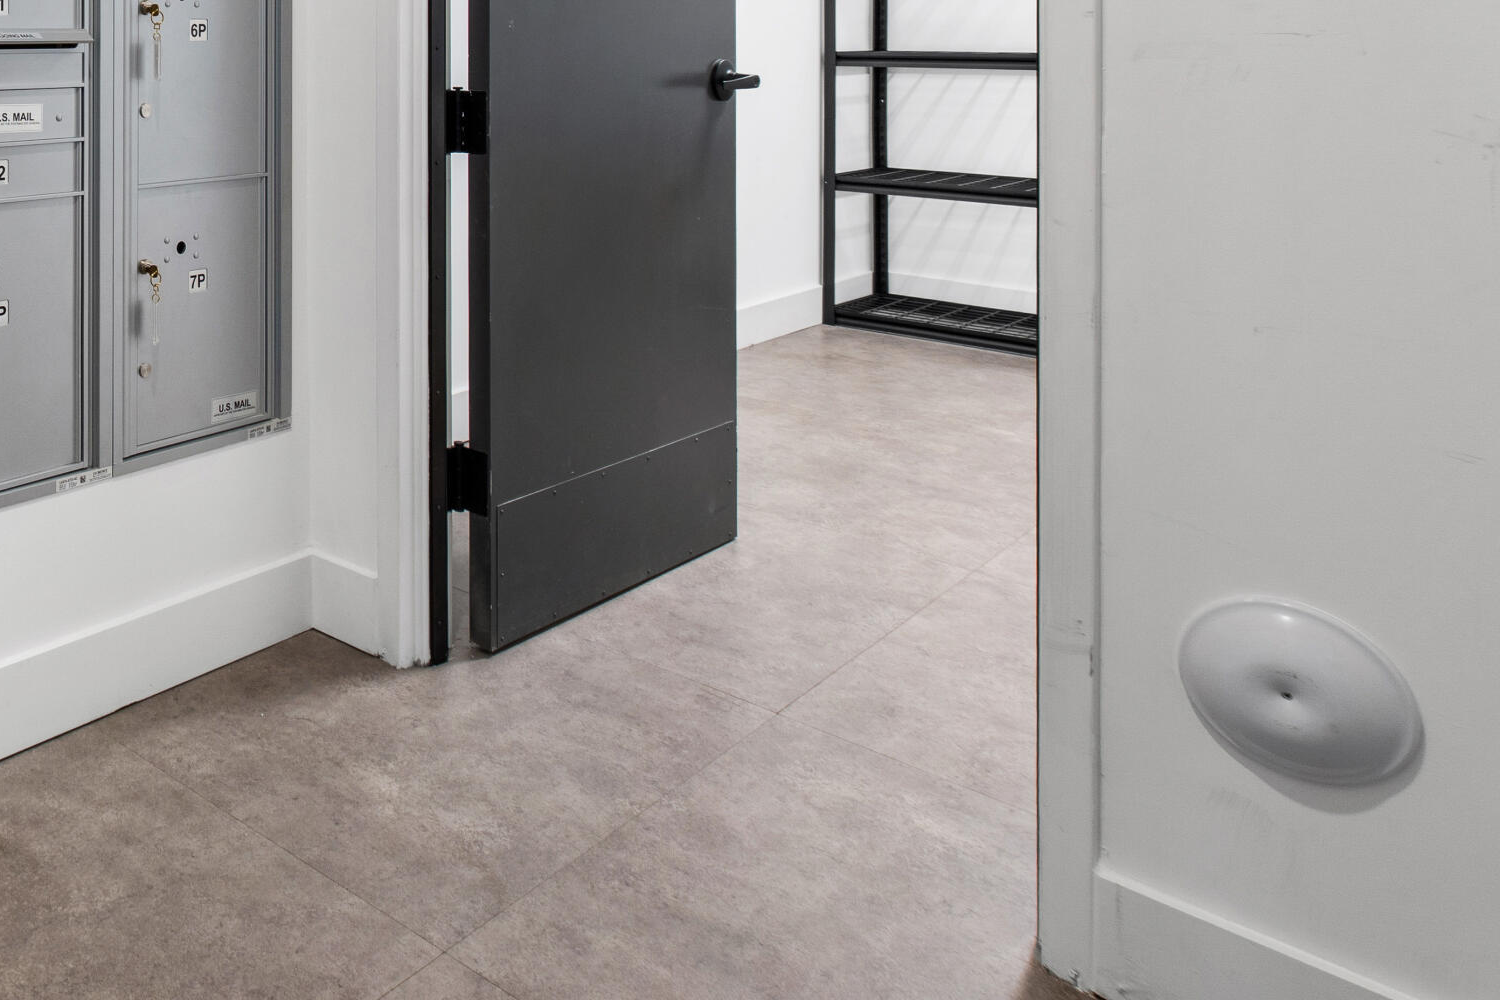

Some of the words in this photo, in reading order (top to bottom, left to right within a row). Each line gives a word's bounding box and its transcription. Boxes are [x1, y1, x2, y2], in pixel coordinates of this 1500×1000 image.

[190, 23, 207, 38] 6P
[12, 111, 35, 121] MAIL
[190, 273, 206, 289] 7P
[219, 403, 233, 413] U.S.
[234, 398, 251, 409] MAIL
